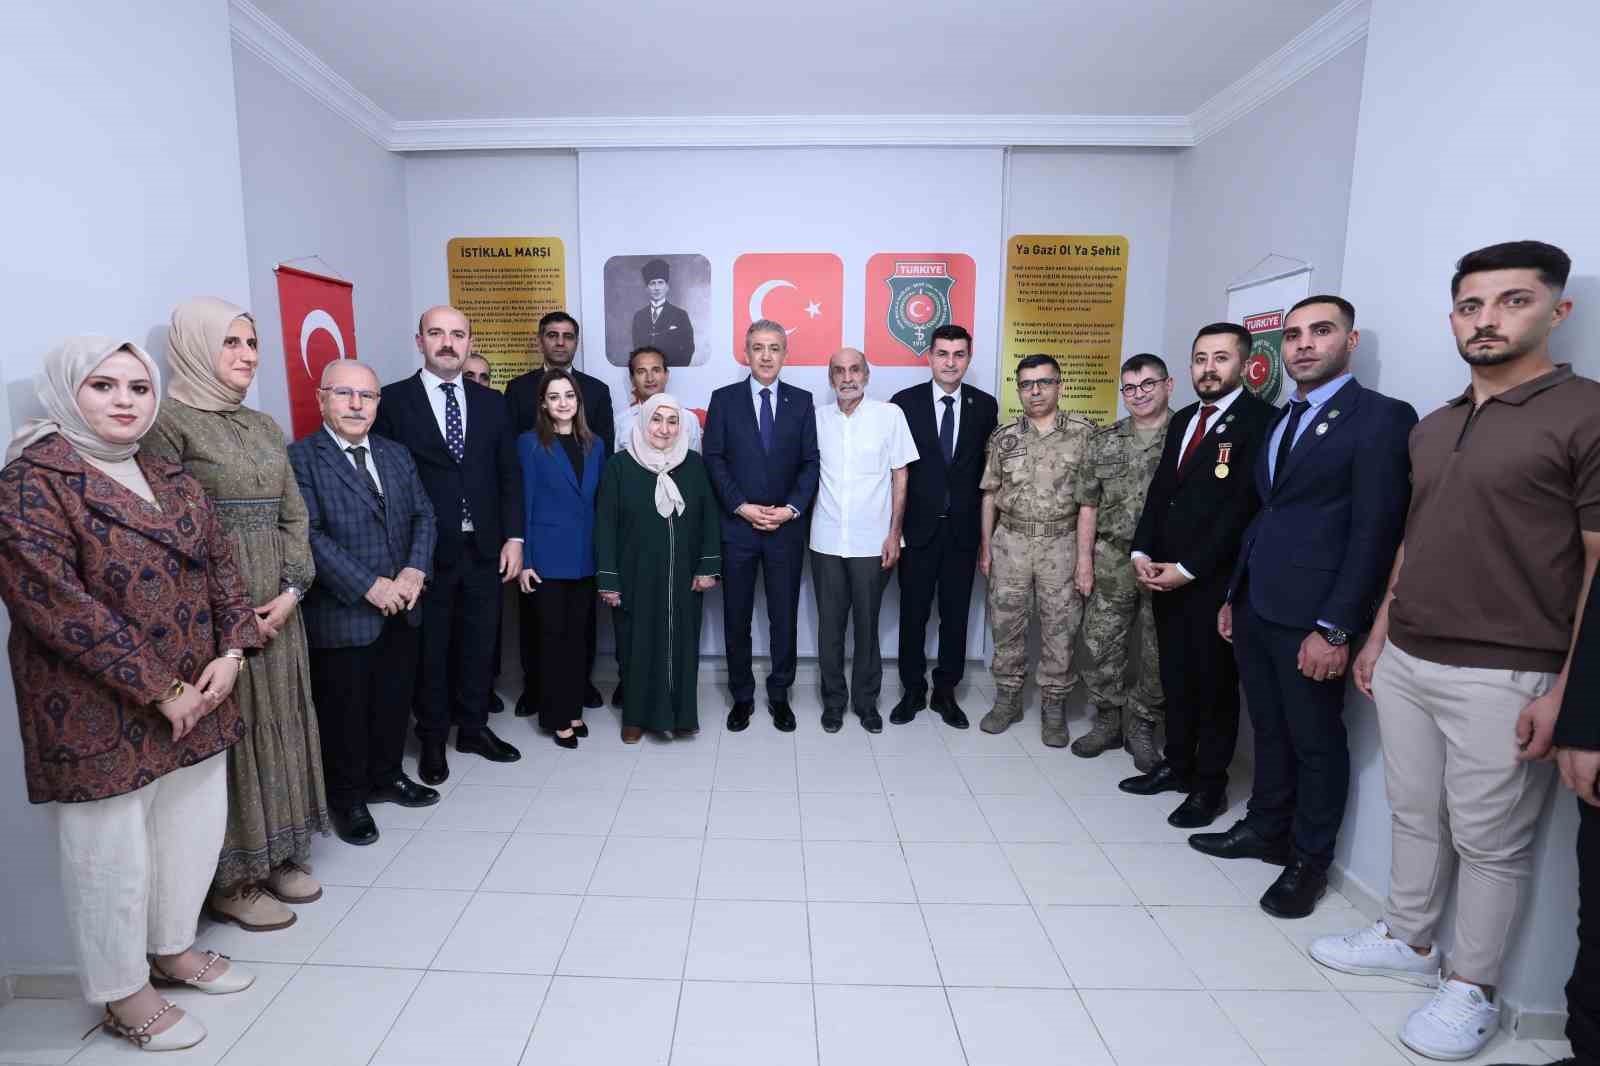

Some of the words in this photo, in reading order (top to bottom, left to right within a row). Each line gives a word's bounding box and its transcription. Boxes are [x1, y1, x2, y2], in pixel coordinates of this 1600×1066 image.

[461, 245, 512, 257] İSTİKLAL
[515, 247, 551, 259] MARŞI
[1016, 244, 1029, 255] Ya
[1032, 244, 1056, 255] Gazi
[1059, 245, 1071, 255] Ol
[1074, 245, 1088, 256] Ya
[1091, 245, 1120, 257] Şehit
